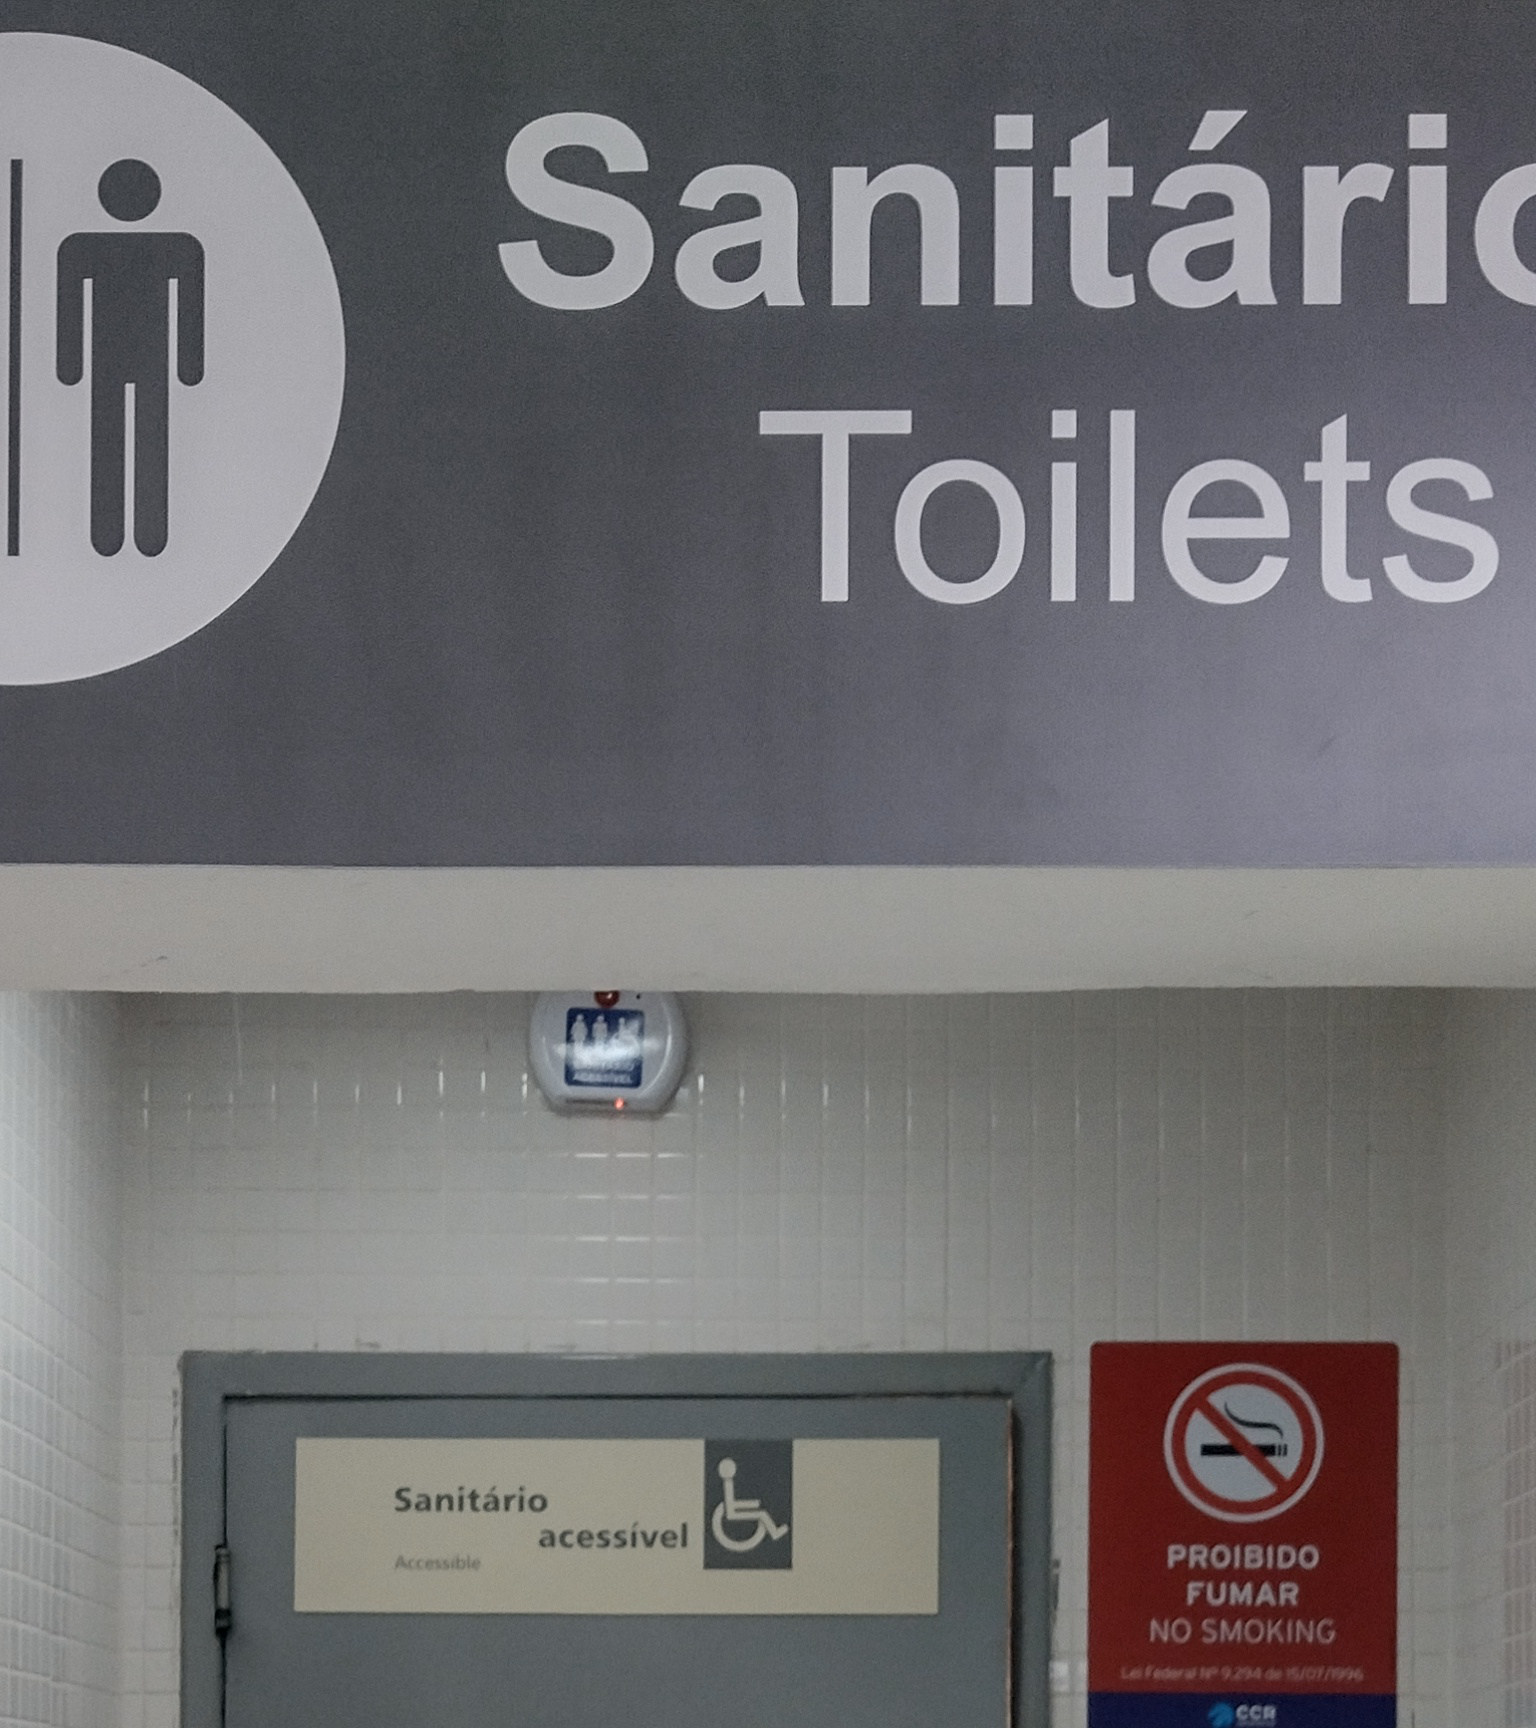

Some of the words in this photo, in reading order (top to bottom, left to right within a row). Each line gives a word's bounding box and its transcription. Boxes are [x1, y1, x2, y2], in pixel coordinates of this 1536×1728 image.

[758, 408, 1501, 605] Toilets
[394, 1485, 549, 1514] Sanitário
[538, 1521, 688, 1550] acessível
[394, 1554, 482, 1572] Accessible
[1167, 1545, 1320, 1570] PROIBIDO
[1186, 1582, 1300, 1607] FUMAR
[1149, 1618, 1193, 1644] NO
[1201, 1618, 1337, 1645] SMOKING
[1236, 1704, 1277, 1721] CCR
